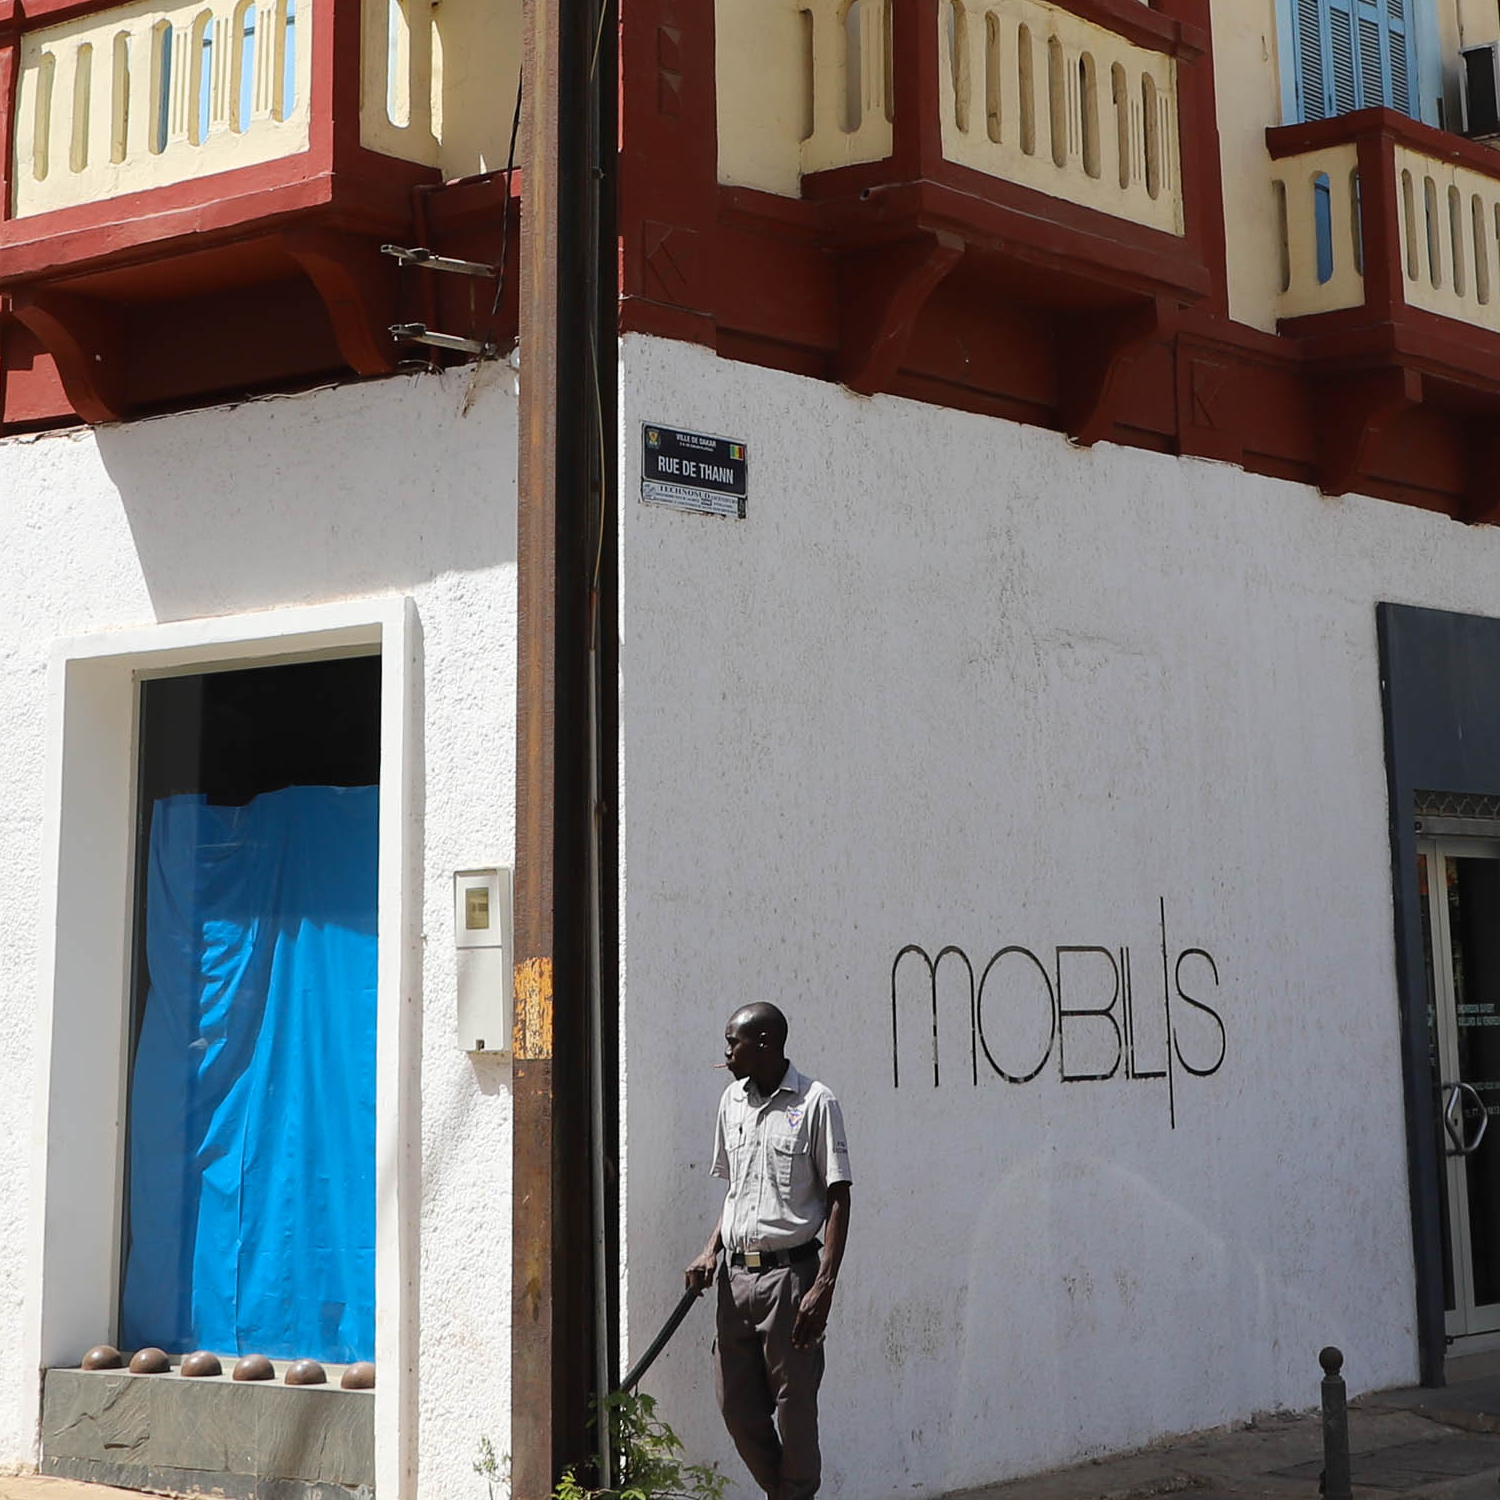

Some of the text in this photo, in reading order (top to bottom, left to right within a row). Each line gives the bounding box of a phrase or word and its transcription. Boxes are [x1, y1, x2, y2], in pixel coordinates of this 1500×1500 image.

[676, 433, 690, 443] VILLE
[691, 437, 699, 446] DE
[699, 438, 717, 448] DAKAR
[658, 455, 734, 485] RUE DE THANN
